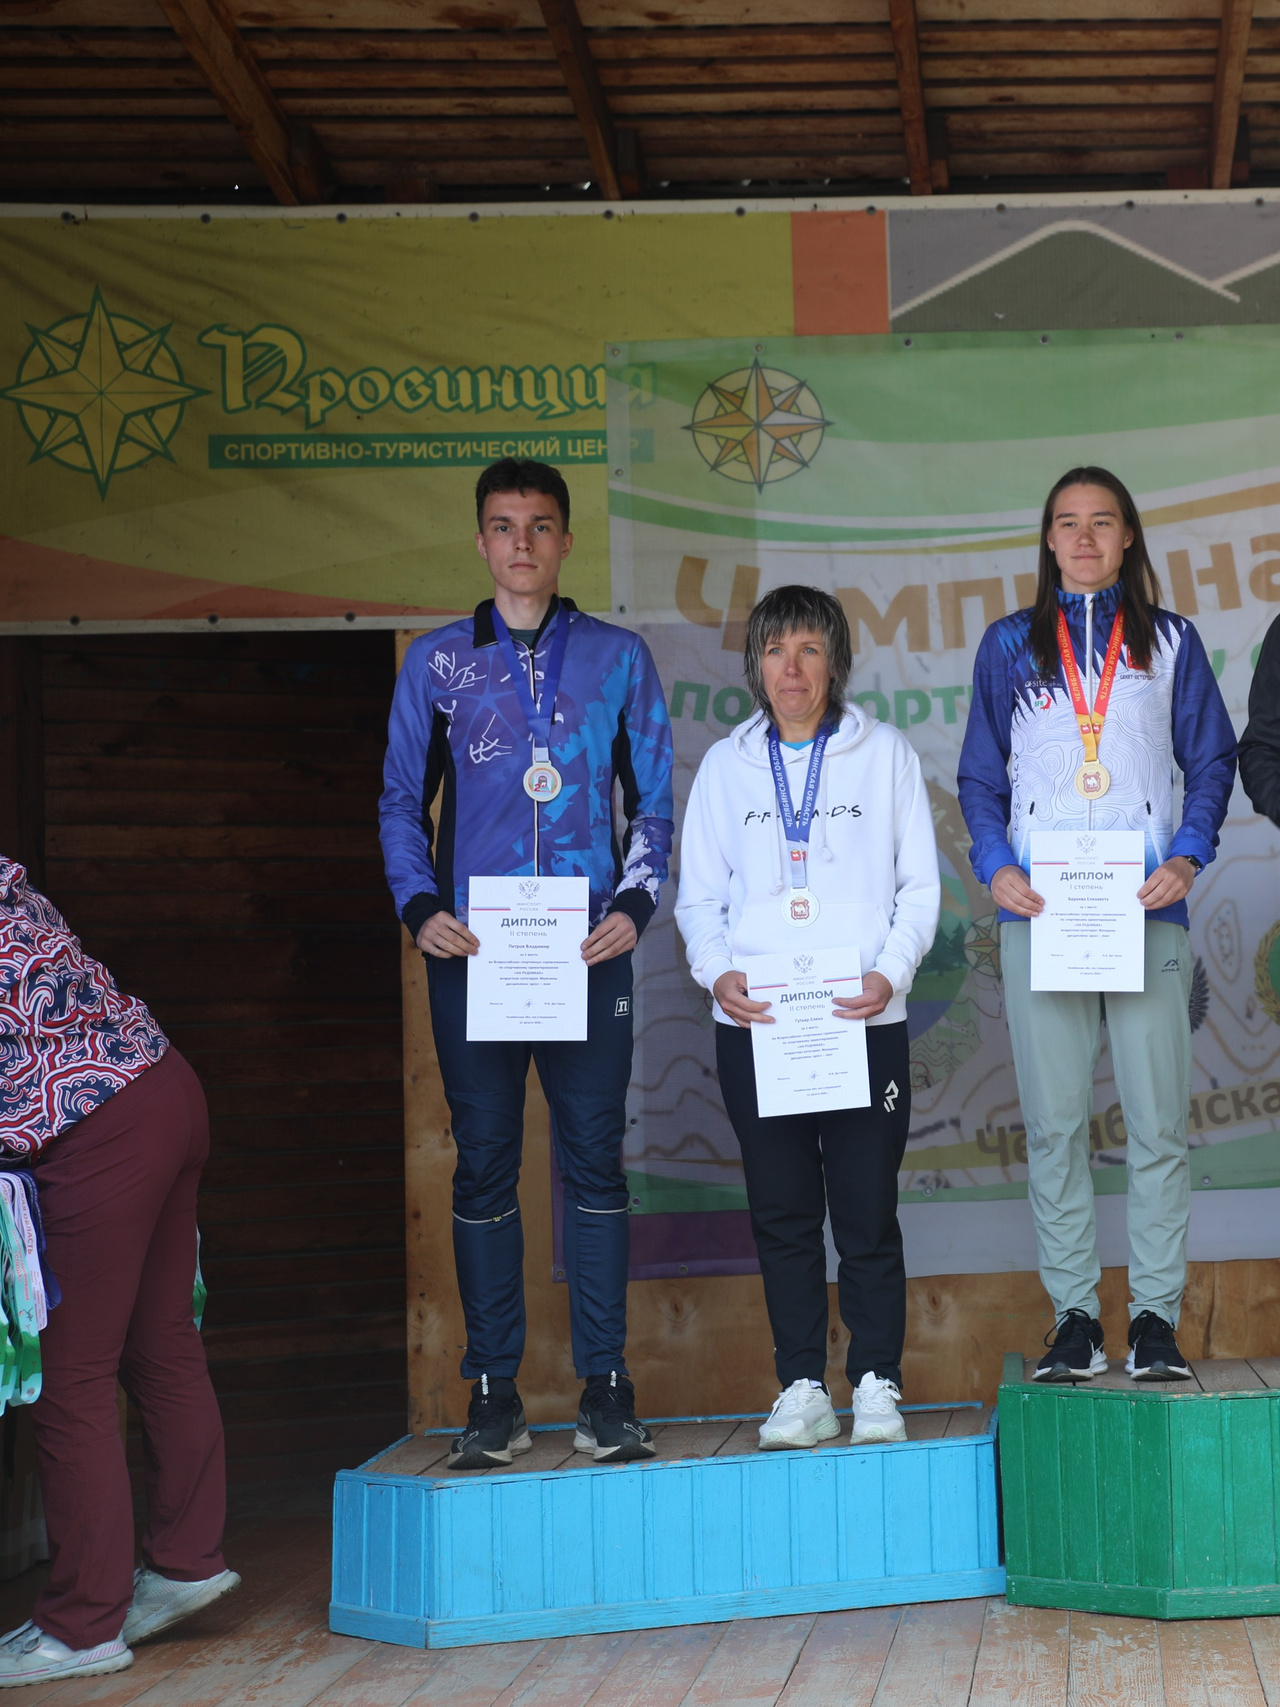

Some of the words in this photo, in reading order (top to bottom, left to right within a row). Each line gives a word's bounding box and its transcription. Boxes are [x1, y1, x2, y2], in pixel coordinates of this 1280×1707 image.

[224, 436, 561, 461] СПОРТИВНО-ТУРИСТИЧЕСКИЙ
[1062, 647, 1081, 702] ЧЕЛЯБИНСКАЯ
[1100, 665, 1112, 700] ОБЛАСТЬ
[770, 739, 782, 771] ОБЛАСТЬ
[808, 735, 825, 790] ЧЕЛЯБИНСКАЯ
[776, 772, 792, 828] ЧЕЛЯБИНСКАЯ
[801, 789, 814, 826] ОБЛАСТЬ
[1060, 871, 1114, 881] ДИПЛОМ
[501, 918, 557, 928] ДИПЛОМ
[780, 989, 834, 1004] ДИПЛОМ
[23, 1213, 34, 1255] ОБЛАСТЬ
